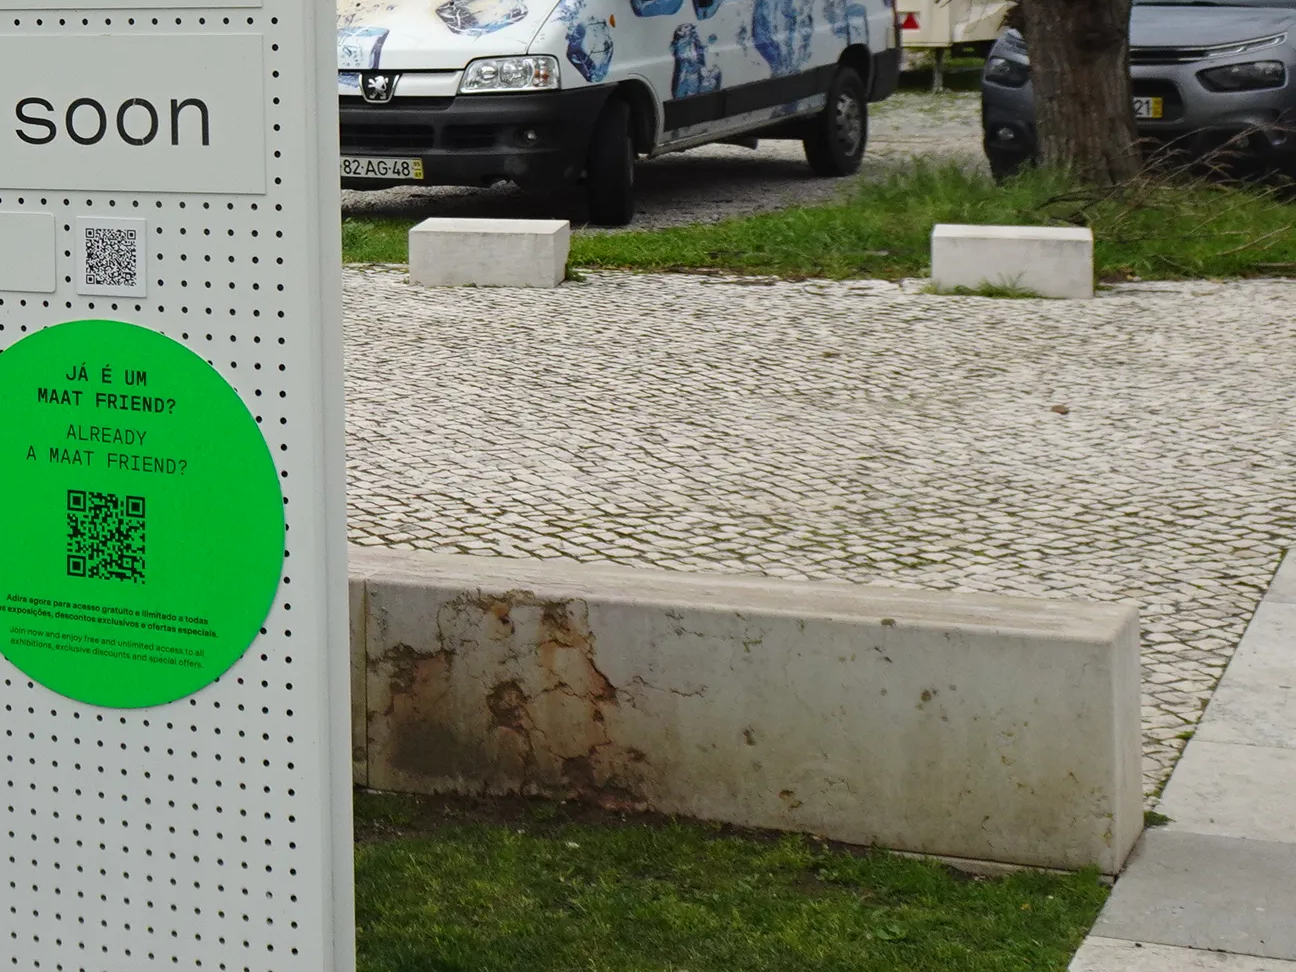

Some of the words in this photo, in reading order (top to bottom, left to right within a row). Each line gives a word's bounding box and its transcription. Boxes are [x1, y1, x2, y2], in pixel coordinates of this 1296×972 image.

[15, 97, 211, 146] soon
[343, 159, 411, 177] 82-AG-48
[65, 361, 88, 382] JÁ
[102, 364, 112, 384] É
[125, 369, 147, 387] UM
[37, 387, 83, 406] MAAT
[96, 392, 176, 414] FRIEND?
[66, 424, 147, 446] ALREADY
[26, 445, 37, 461] A
[49, 447, 94, 466] MAAT
[107, 452, 188, 476] FRIEND?
[6, 594, 27, 603] Adira
[29, 597, 51, 606] agora
[53, 600, 71, 608] para
[73, 602, 100, 612] acesso
[102, 606, 133, 617] gratuito
[142, 610, 177, 622] ilimitado
[185, 615, 209, 625] todas
[55, 610, 96, 623] descontos
[98, 617, 139, 629] exclusivos
[147, 622, 176, 633] ofertas
[10, 626, 26, 635] Join
[28, 629, 44, 637] now
[45, 631, 60, 639] and
[62, 633, 82, 643] enjoy
[84, 634, 100, 644] free
[101, 637, 116, 646] and
[117, 639, 154, 651] unlimited
[156, 644, 184, 655] access
[55, 643, 91, 655] exclusive
[92, 647, 131, 660] discounts
[132, 653, 147, 662] and
[149, 655, 177, 665] special
